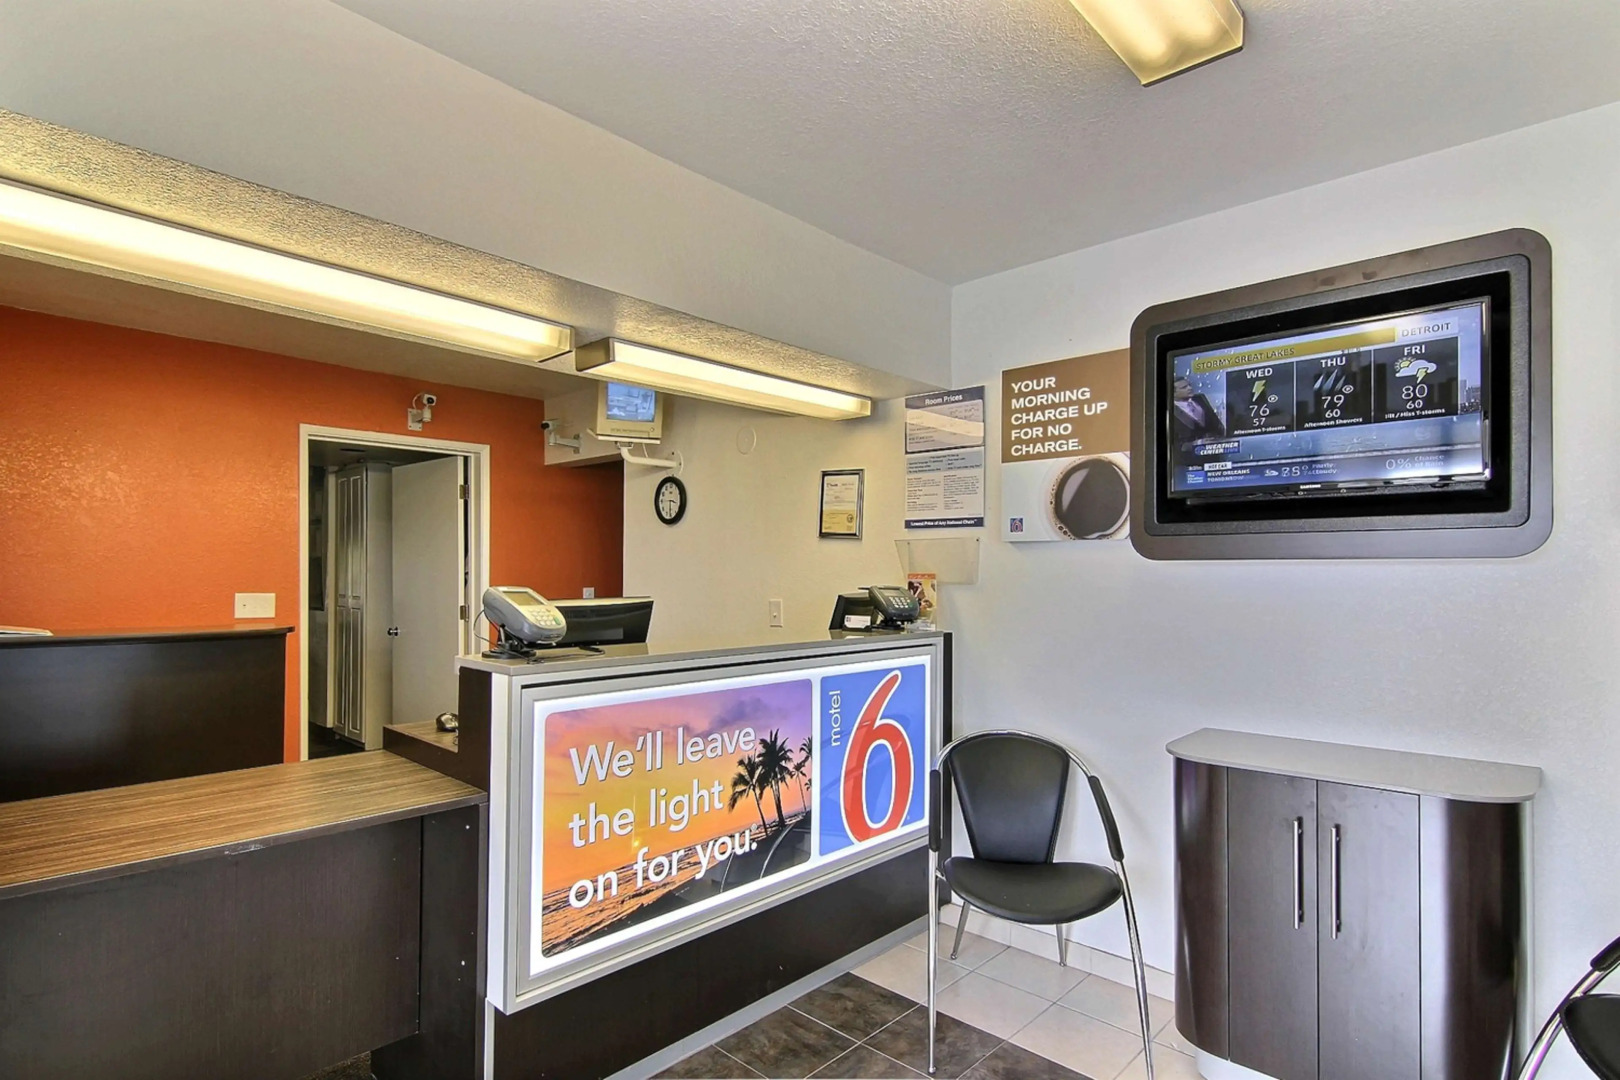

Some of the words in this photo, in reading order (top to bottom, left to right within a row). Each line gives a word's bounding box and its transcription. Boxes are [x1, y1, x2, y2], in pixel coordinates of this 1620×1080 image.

[1402, 322, 1450, 337] DETROIT
[1404, 345, 1425, 356] FRI
[1196, 358, 1232, 370] STORMY
[1234, 354, 1263, 364] GREAT
[1266, 348, 1295, 359] LAKES
[1320, 356, 1346, 368] THU
[1246, 368, 1272, 378] WED
[1011, 377, 1056, 393] YOUR
[1402, 384, 1428, 399] 80
[1012, 388, 1090, 410] MORNING
[1322, 395, 1344, 409] 79
[1406, 399, 1423, 409] 60
[1011, 406, 1078, 425] CHARGE
[1084, 402, 1108, 416] UP
[1249, 404, 1270, 418] 76
[1325, 409, 1340, 418] 60
[1253, 418, 1266, 426] 57
[1012, 427, 1043, 440] FOR
[1048, 423, 1072, 436] NO
[1011, 439, 1082, 456] CHARGE.
[1386, 458, 1412, 470] 0%
[829, 690, 841, 746] motel
[569, 730, 662, 786] We'll
[676, 727, 756, 765] leave
[840, 670, 914, 846] 6
[568, 802, 634, 848] the
[649, 778, 724, 832] light
[568, 868, 618, 909] on
[633, 847, 685, 890] for
